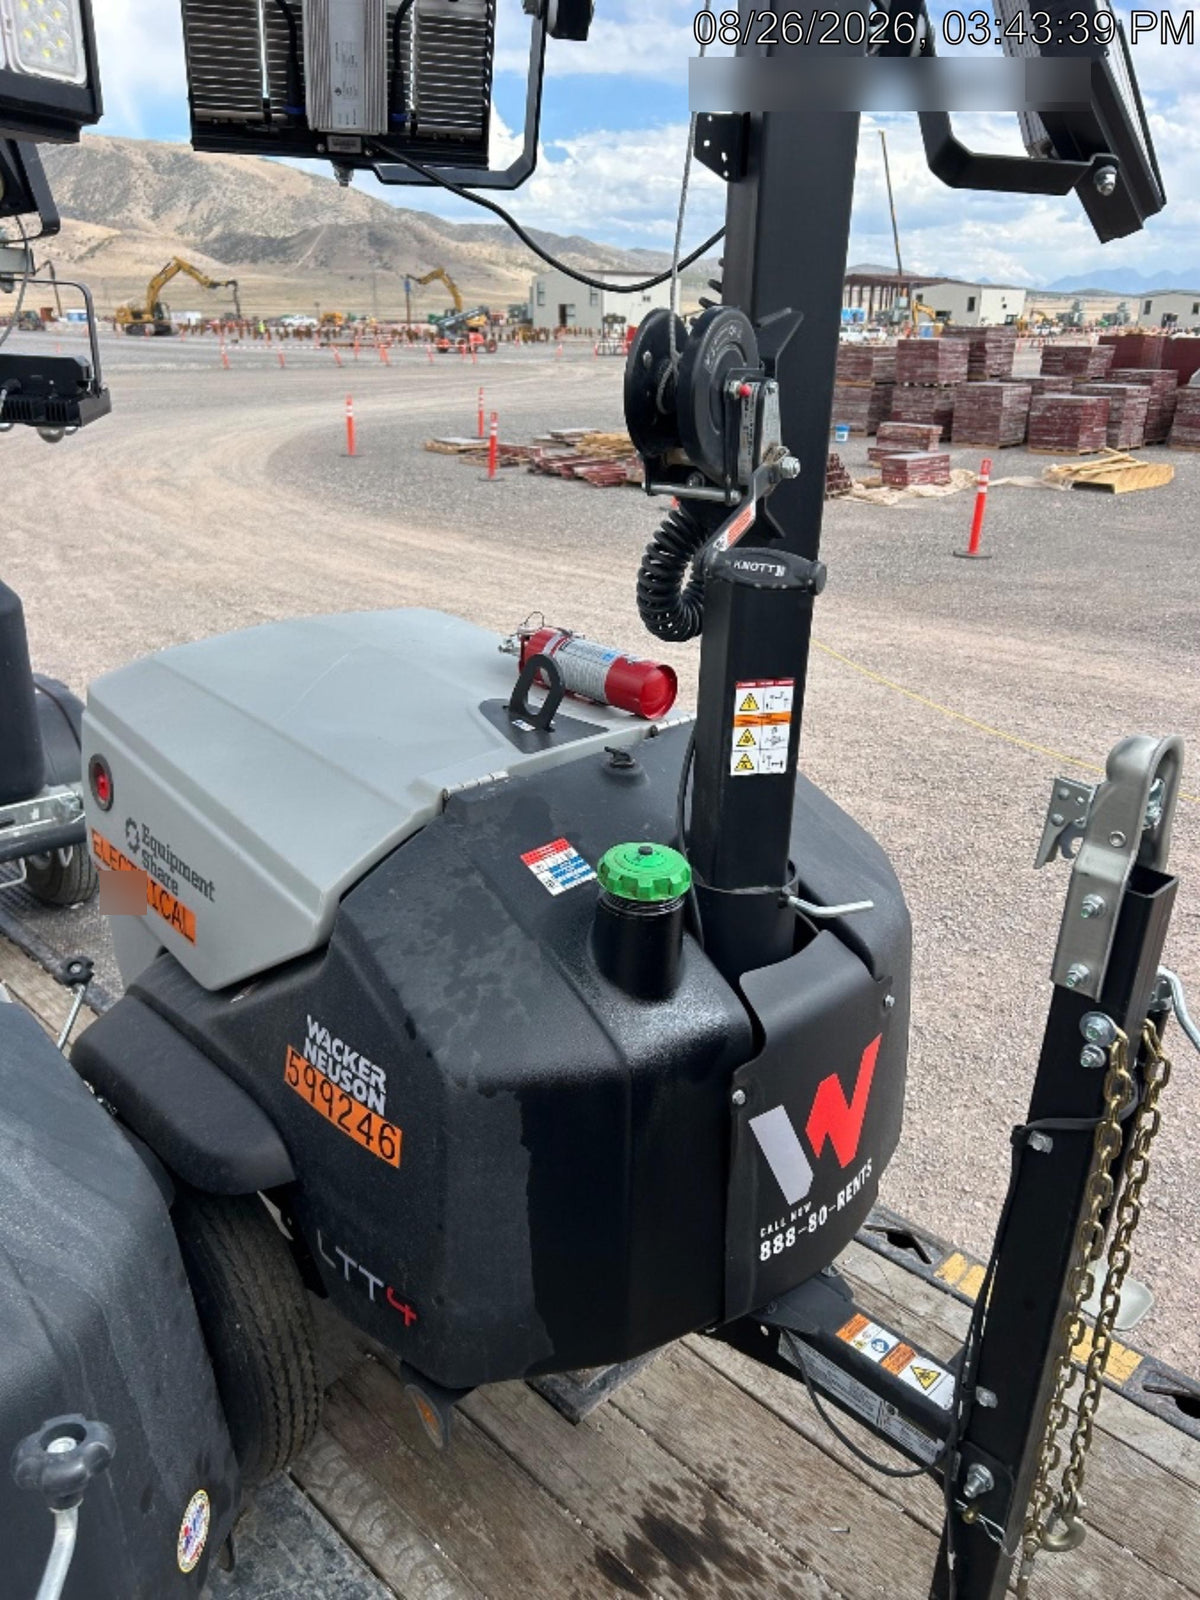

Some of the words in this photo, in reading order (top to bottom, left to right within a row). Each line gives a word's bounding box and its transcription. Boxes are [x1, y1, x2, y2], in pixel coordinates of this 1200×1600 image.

[92, 828, 195, 943] ELECICAL
[141, 850, 178, 896] Share
[142, 823, 215, 902] Equipment
[304, 1037, 385, 1116] NEUSON
[307, 1014, 387, 1094] WACKER
[287, 1050, 396, 1160] 599246
[760, 1157, 872, 1261] 888-80-RENTS
[317, 1228, 417, 1327] LTT4
